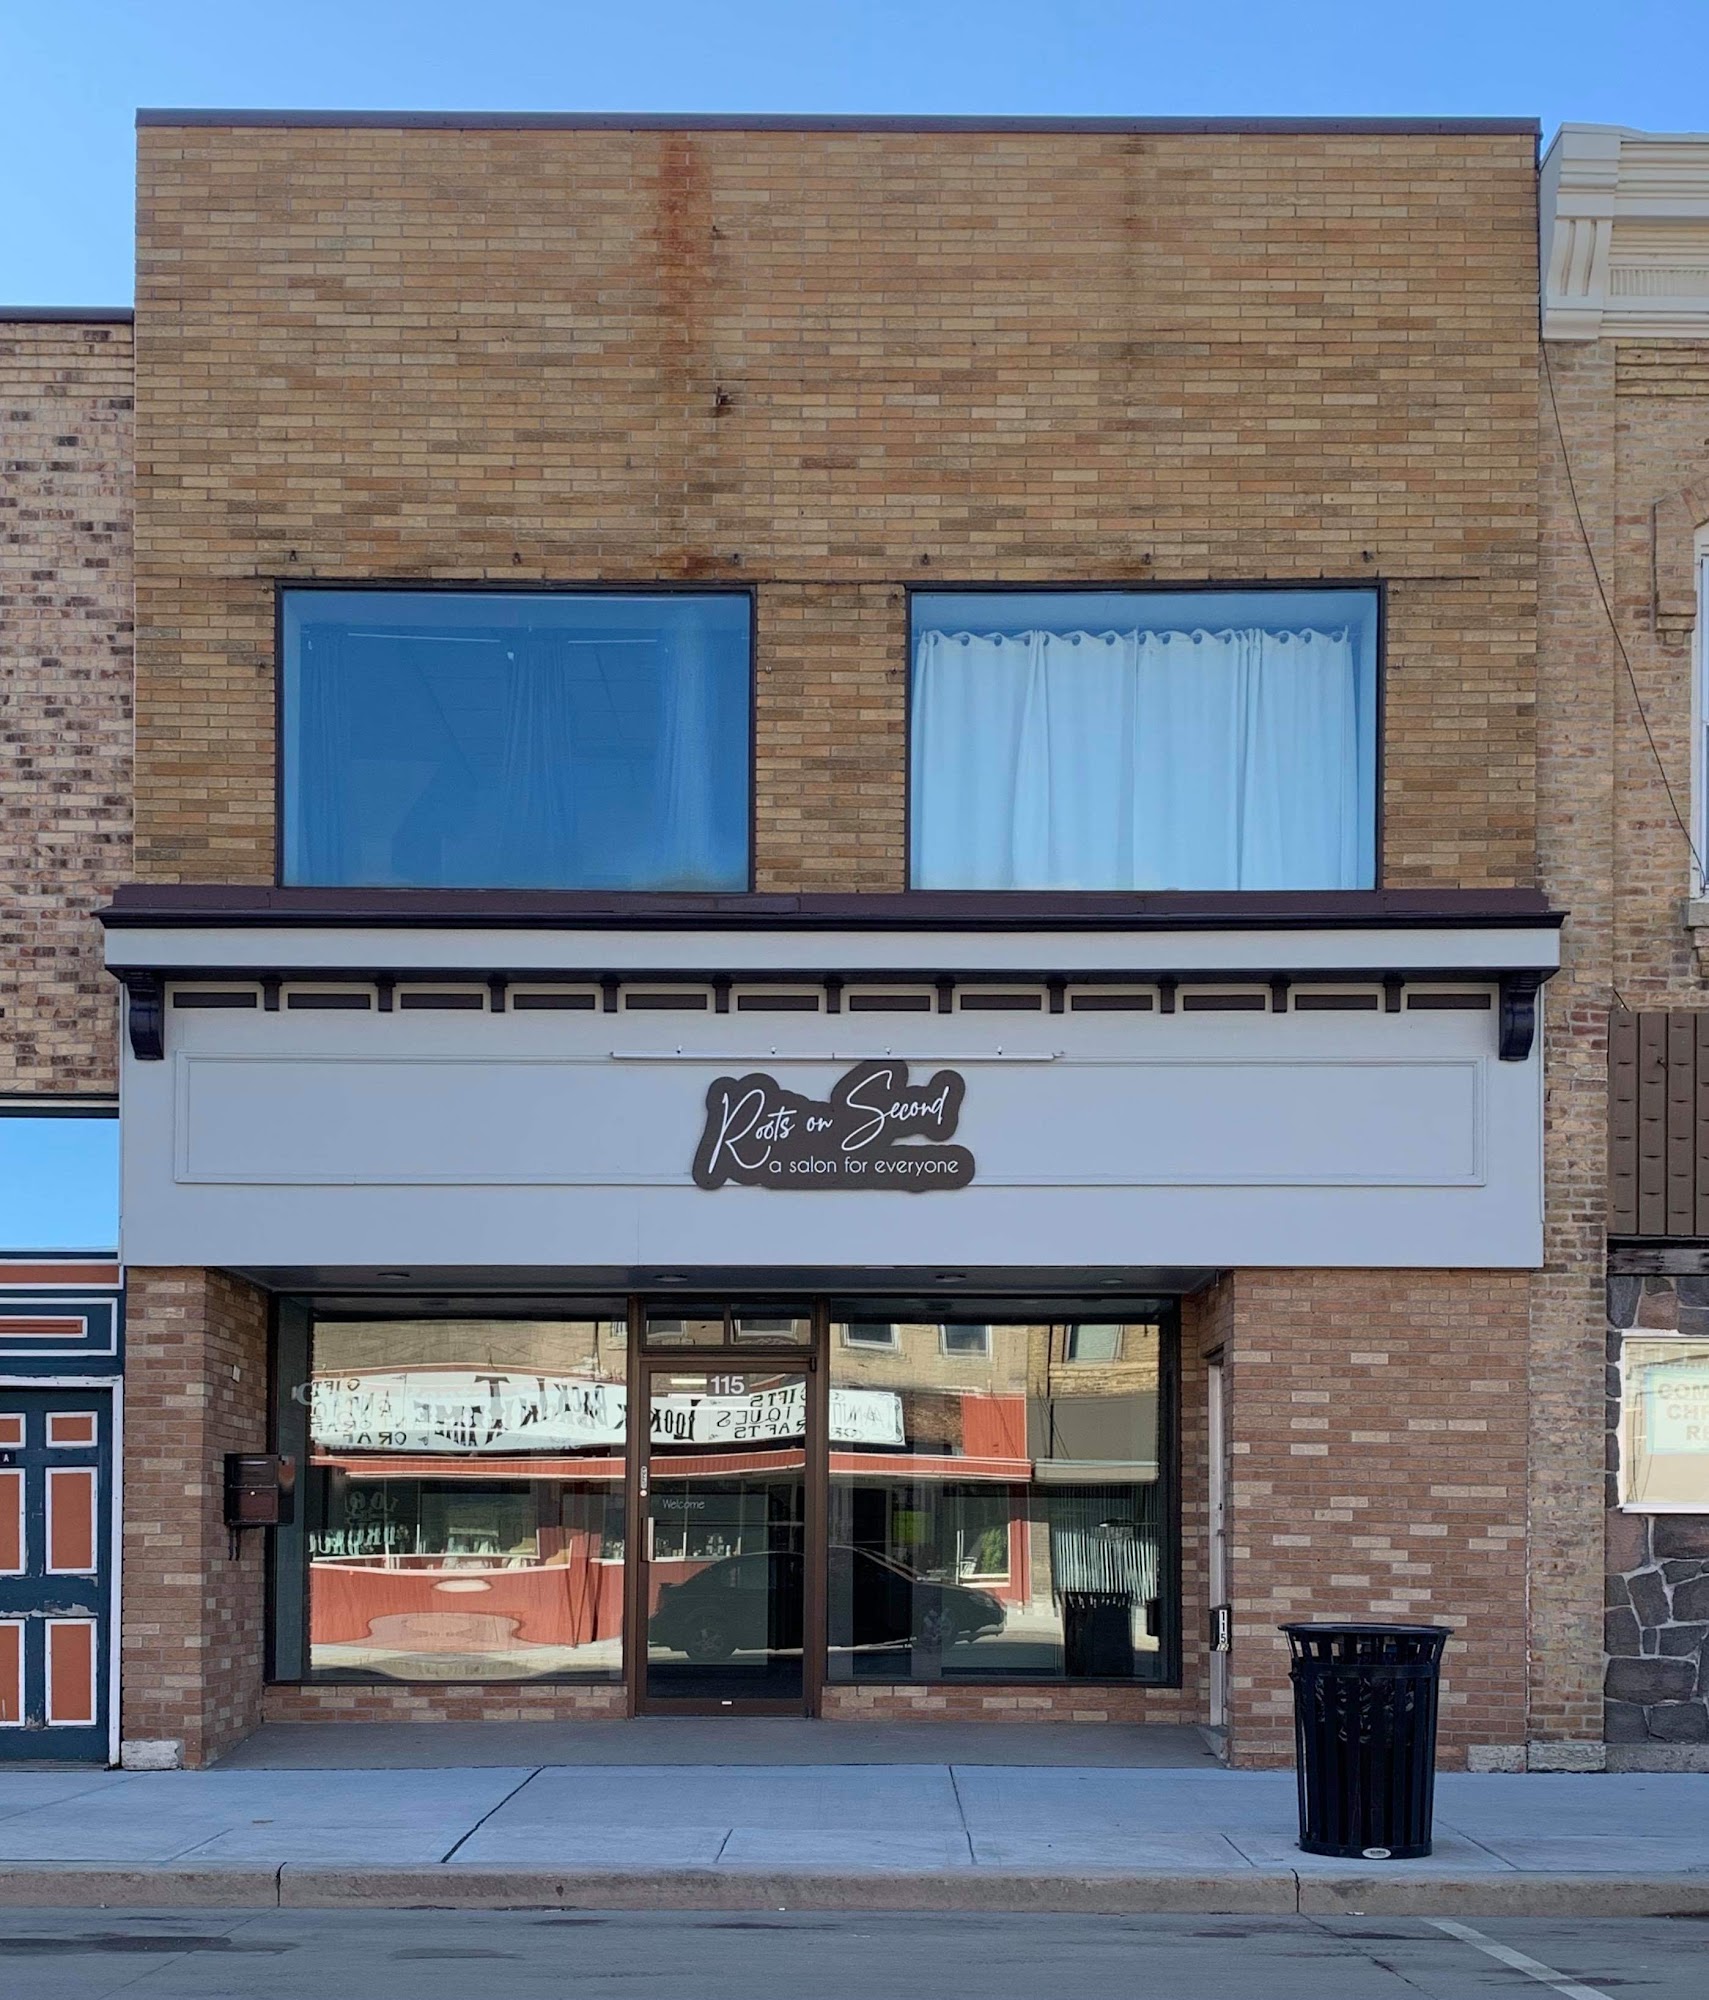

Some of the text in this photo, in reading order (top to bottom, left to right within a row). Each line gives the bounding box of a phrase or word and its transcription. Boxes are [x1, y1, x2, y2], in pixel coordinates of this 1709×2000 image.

[708, 1069, 950, 1174] Roots on Second
[769, 1156, 959, 1177] a salon for everyone
[710, 1375, 745, 1395] 115
[662, 1498, 706, 1510] Welcome
